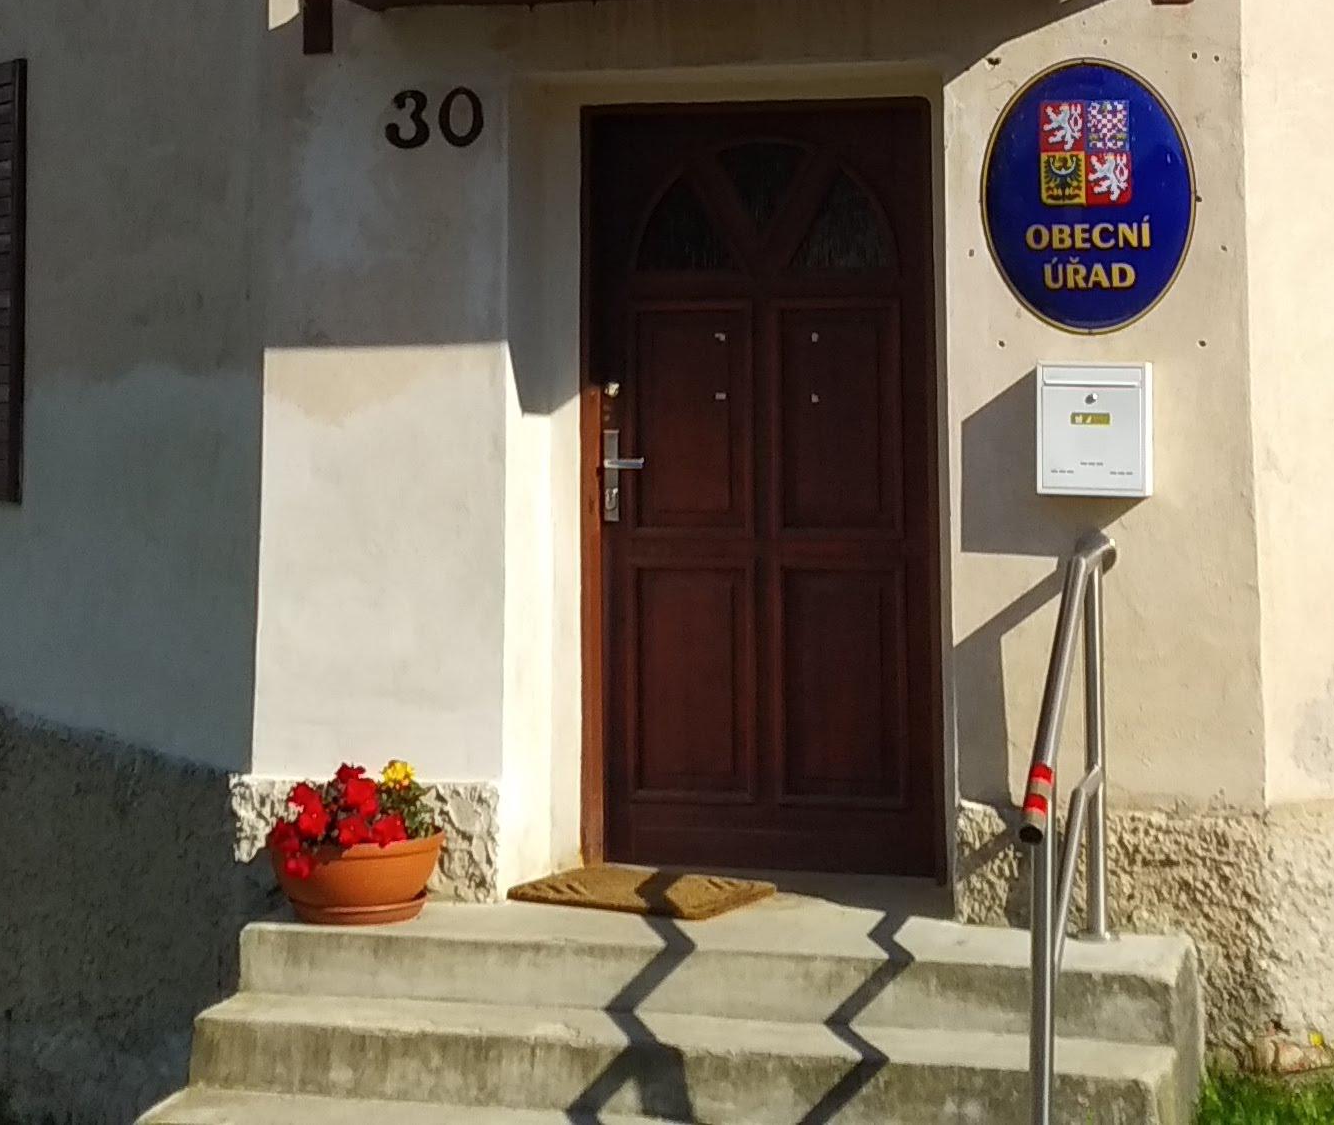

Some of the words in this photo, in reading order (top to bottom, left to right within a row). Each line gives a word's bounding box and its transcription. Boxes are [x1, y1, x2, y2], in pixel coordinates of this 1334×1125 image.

[385, 86, 484, 149] 30
[1025, 215, 1152, 251] OBECNÍ
[1043, 256, 1137, 290] ÚŘAD
